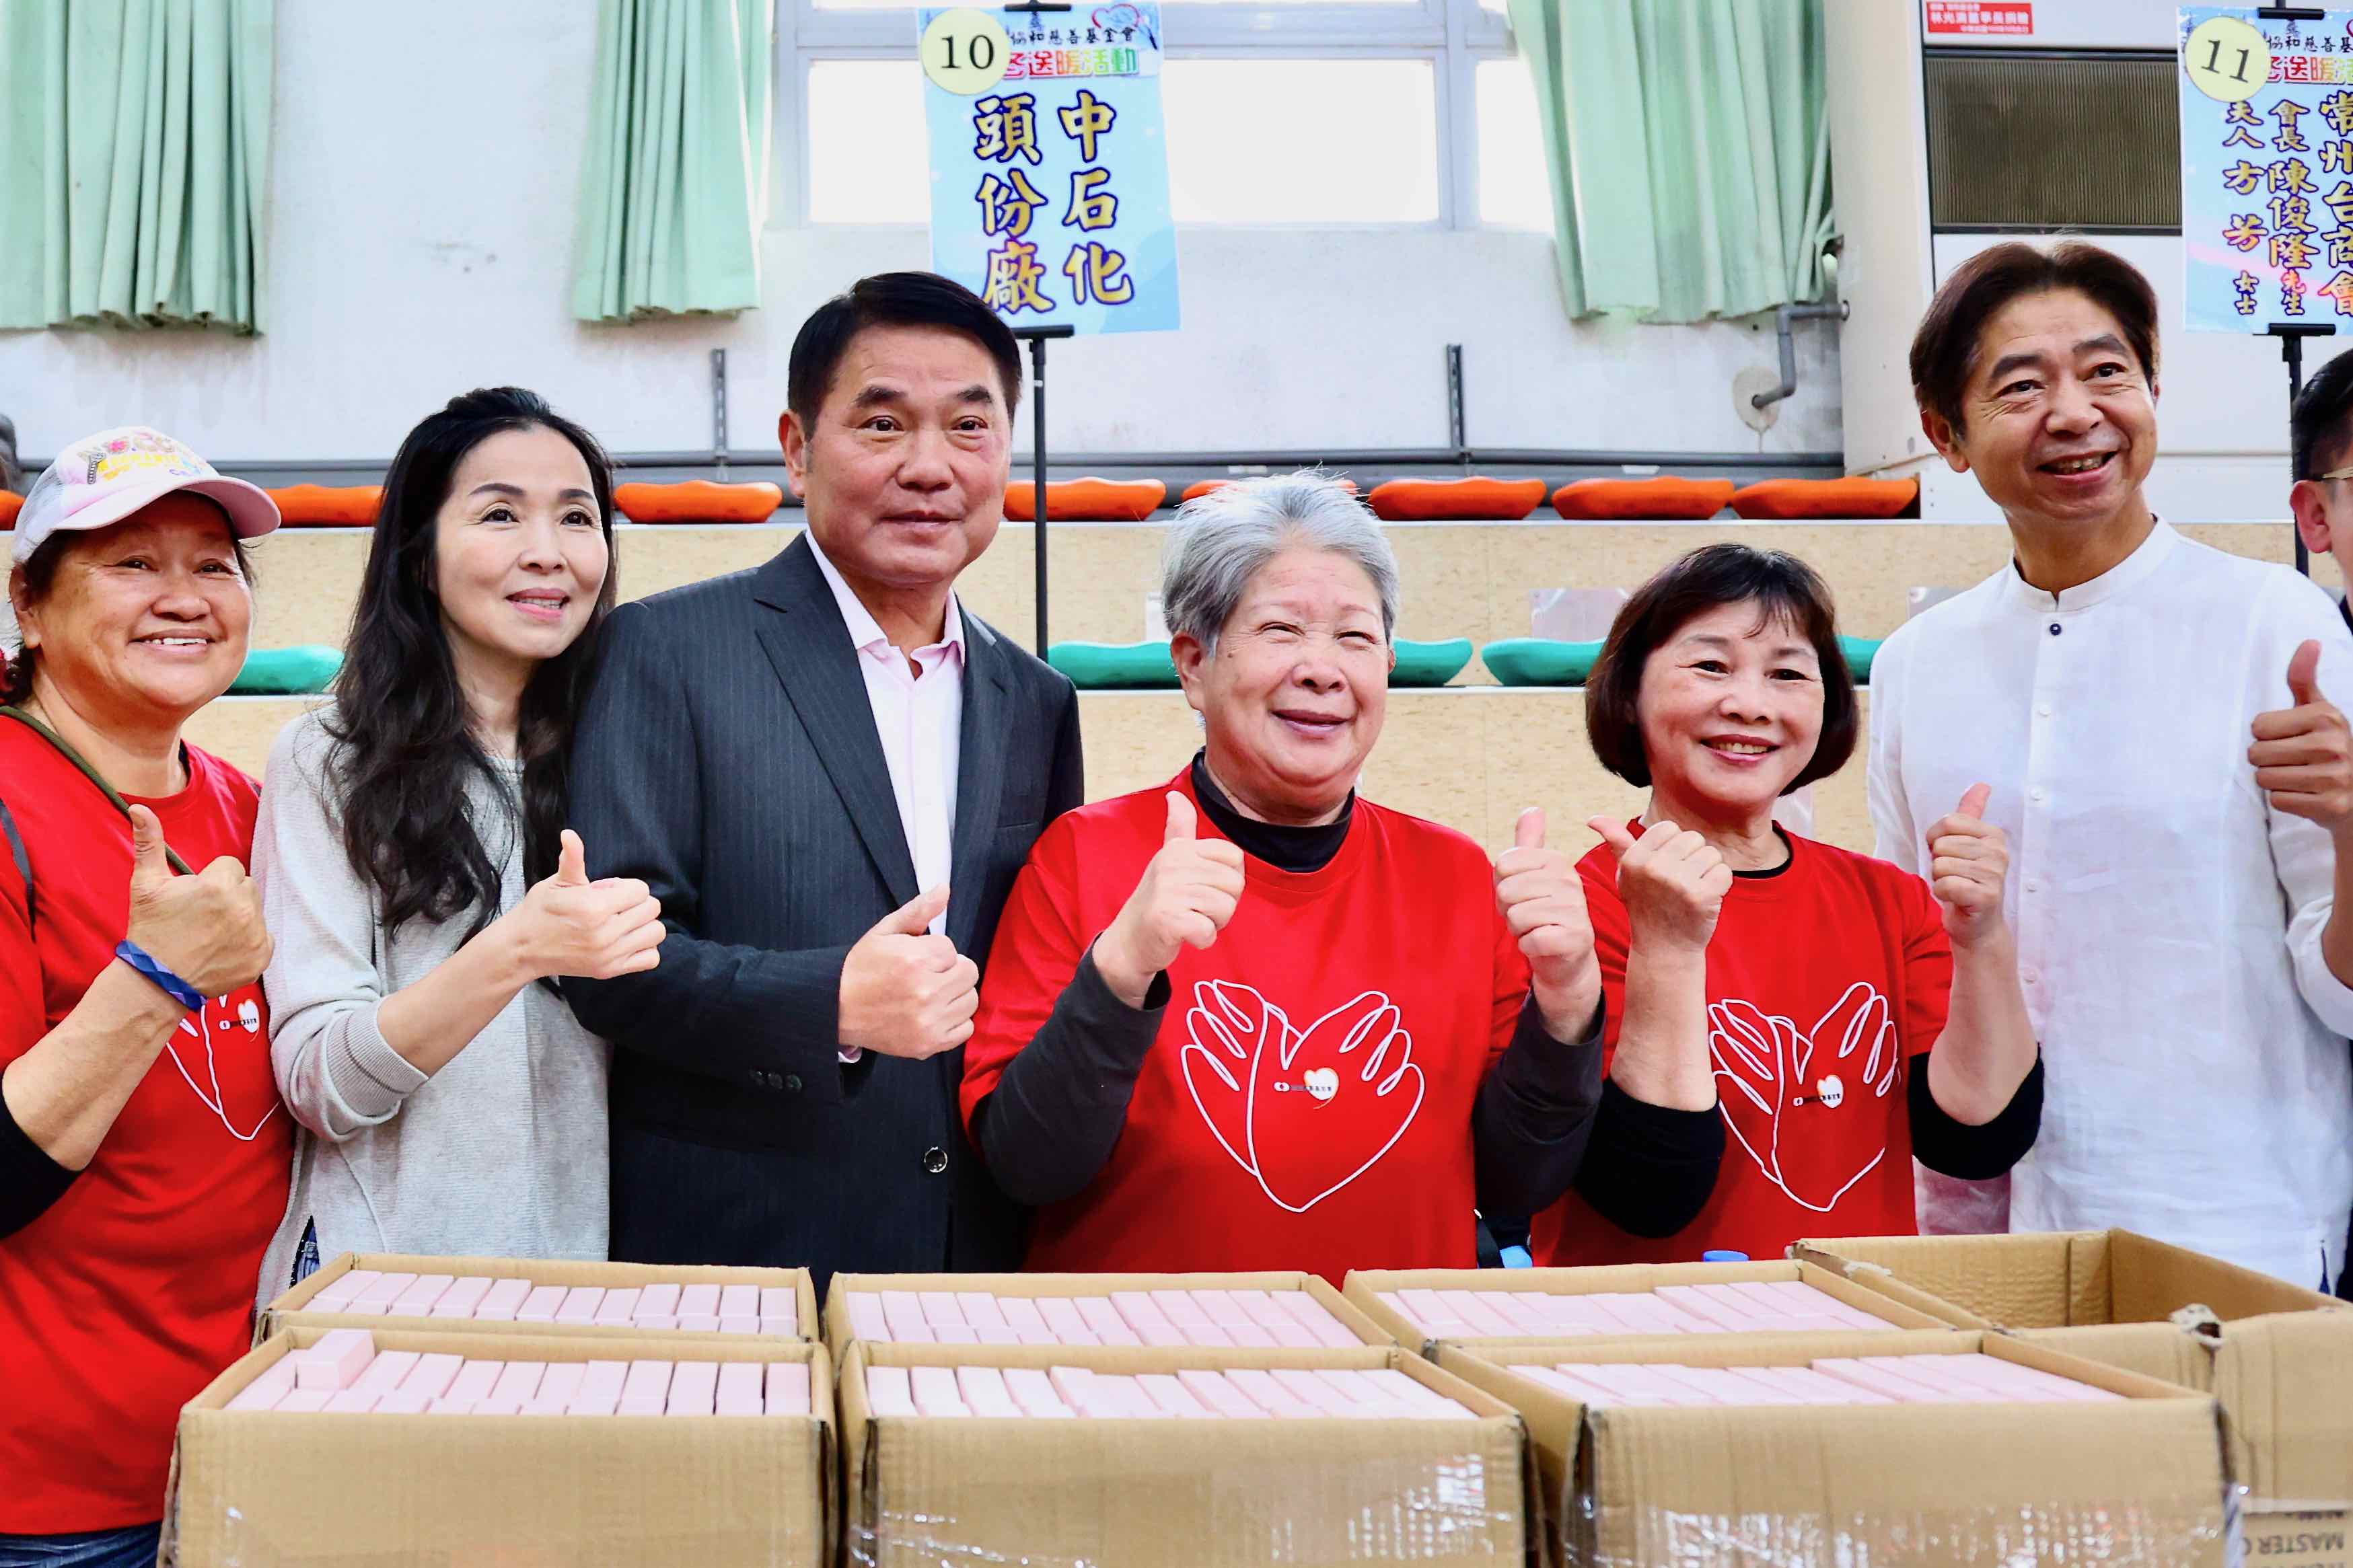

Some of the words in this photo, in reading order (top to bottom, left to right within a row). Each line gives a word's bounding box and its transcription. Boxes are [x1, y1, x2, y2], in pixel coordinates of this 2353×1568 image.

[941, 35, 994, 70] 10
[2201, 39, 2249, 83] 11
[974, 92, 1056, 314] 頭份廠
[1057, 89, 1134, 305] 中石化
[2257, 1532, 2344, 1555] MASTER
